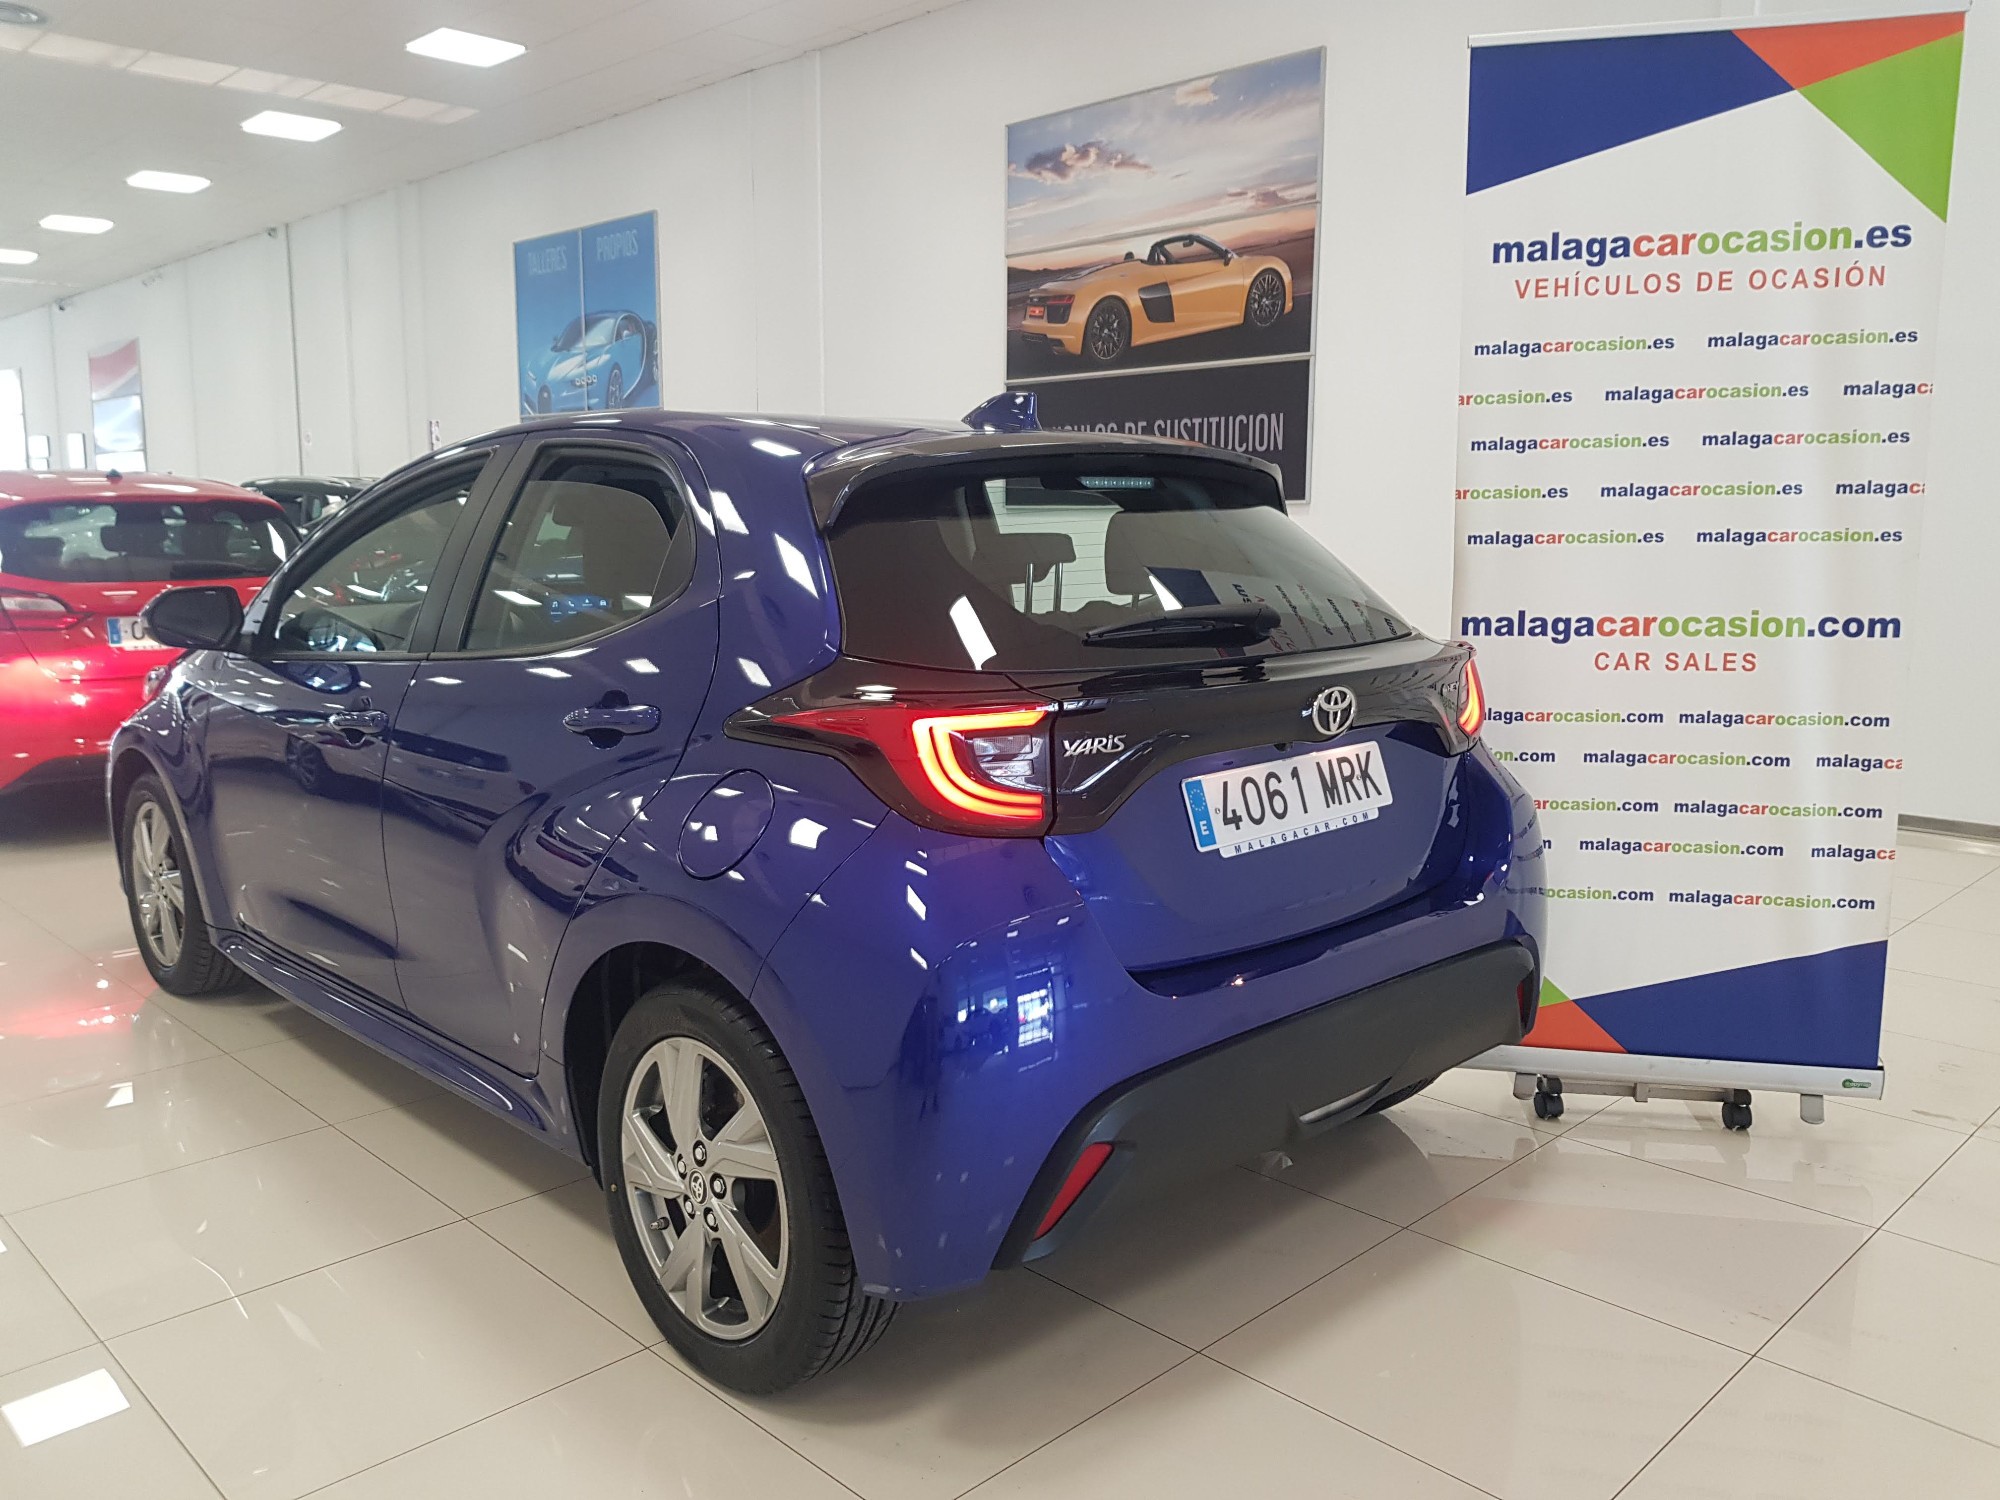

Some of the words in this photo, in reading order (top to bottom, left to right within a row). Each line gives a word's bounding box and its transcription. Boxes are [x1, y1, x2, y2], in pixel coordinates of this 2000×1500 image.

[596, 229, 638, 261] PROPIOS
[1492, 221, 1913, 267] malagacarocasion.es
[1514, 271, 1681, 299] VEHÍCULOS
[1696, 271, 1734, 293] DE
[1748, 260, 1886, 291] OCASIÓN
[1473, 335, 1675, 357] malagacarocasion.es
[1707, 329, 1919, 351] malagacarocasion.es
[1604, 382, 1810, 404] malagacarocasion.es
[1470, 434, 1670, 455] malagacarocasion.es
[1701, 428, 1911, 450] malagacarocasion.es
[1600, 480, 1803, 500] malagacarocasion.es
[1467, 529, 1665, 549] malagacarocasion.es
[1696, 527, 1903, 547] malagacarocasion.es
[1460, 609, 1902, 645] malagacarocasion.com
[1594, 651, 1651, 672] CAR
[1665, 651, 1757, 673] SALES
[1484, 707, 1664, 726] lagacarocasion.com
[1678, 710, 1890, 730] malagacarocasion.com
[1583, 749, 1791, 769] malagacarocasion.com
[1200, 820, 1211, 836] E
[1222, 766, 1309, 831] 4061
[1315, 750, 1383, 810] MRK
[1673, 799, 1883, 819] malagacarocasion.com
[1234, 811, 1369, 855] MALAGACAR.COM
[1579, 838, 1784, 857] malagacarocasion.com
[1668, 889, 1876, 910] malagacarocasion.com
